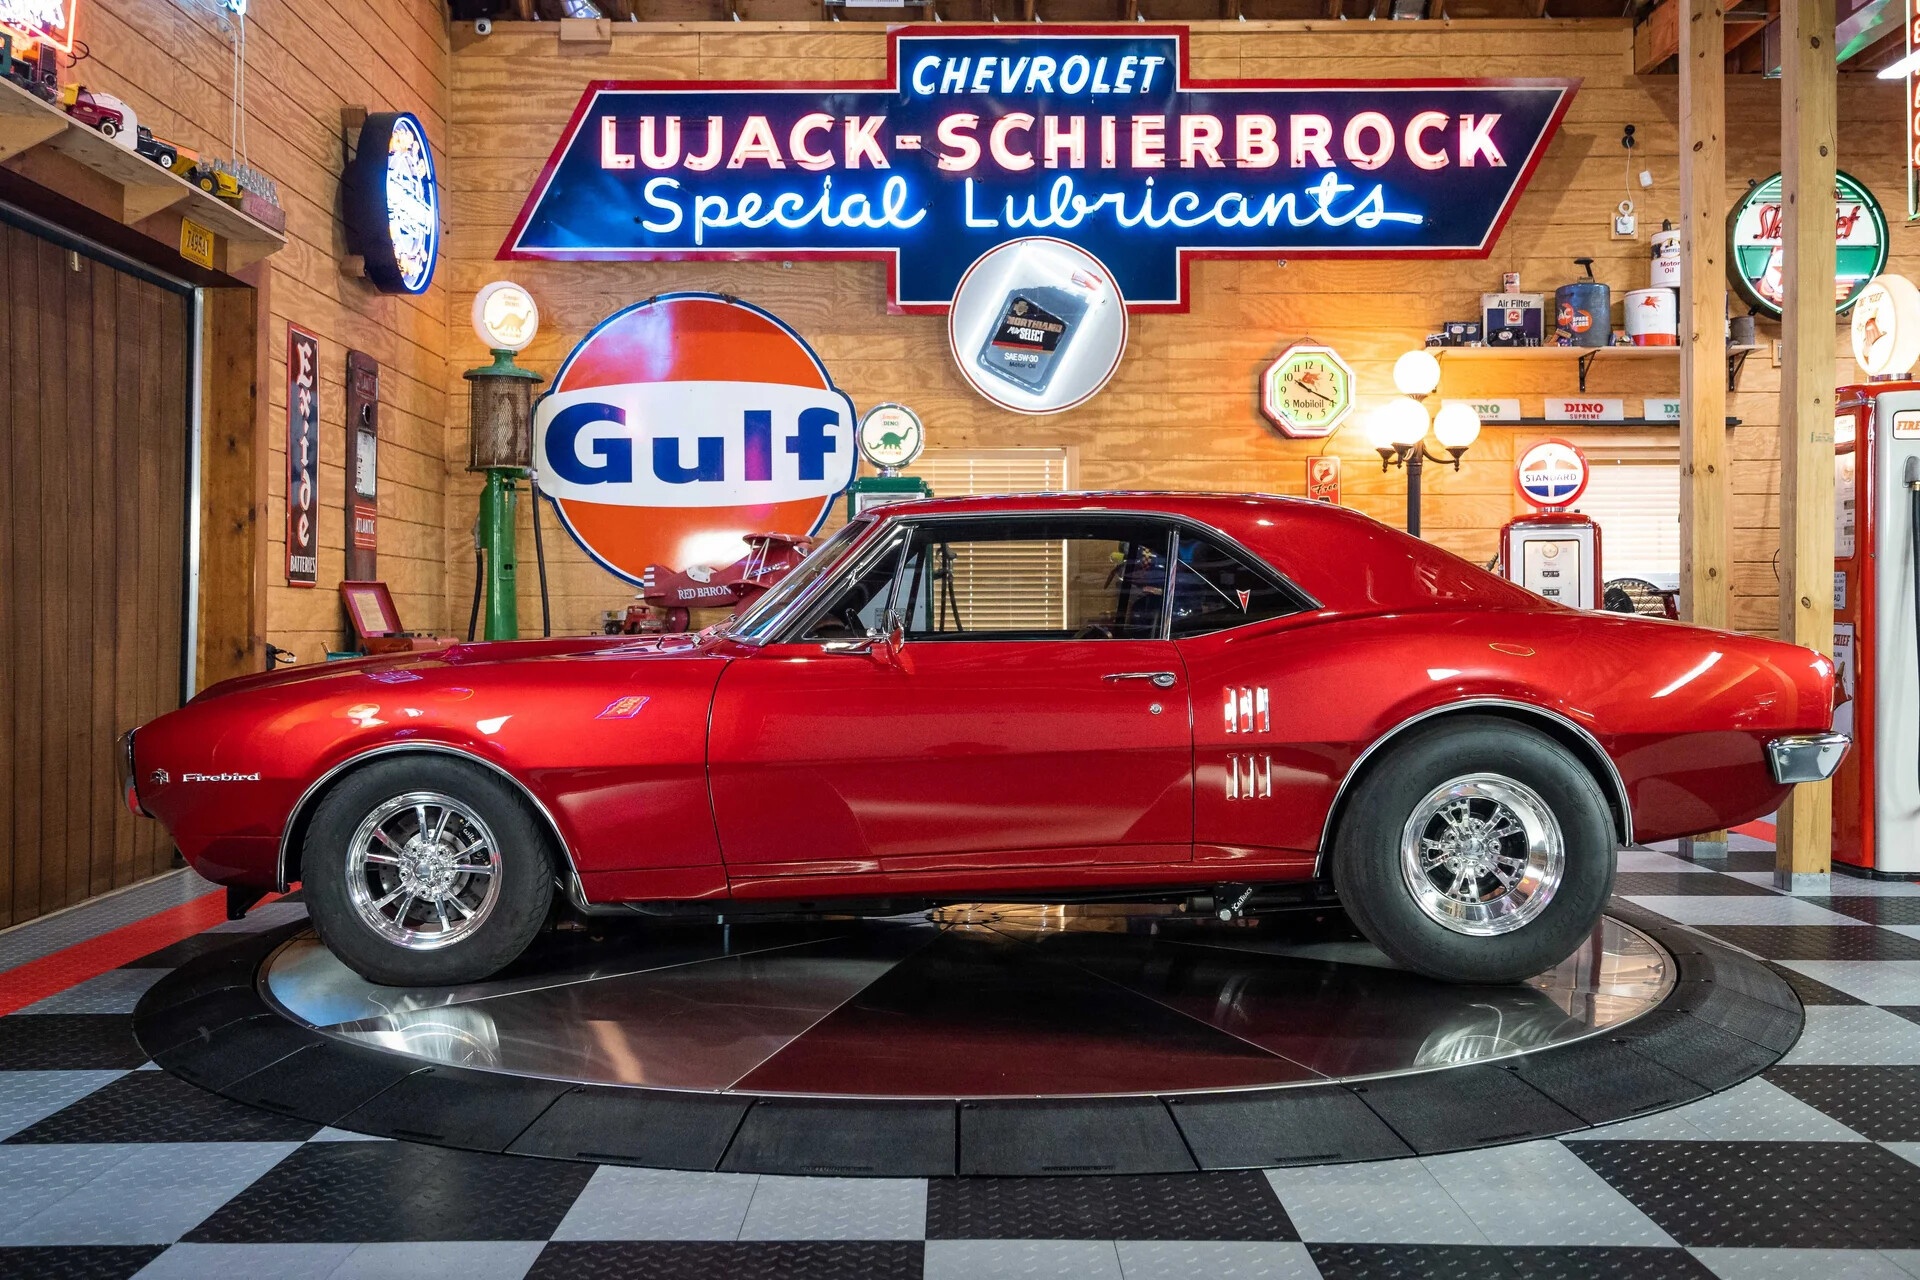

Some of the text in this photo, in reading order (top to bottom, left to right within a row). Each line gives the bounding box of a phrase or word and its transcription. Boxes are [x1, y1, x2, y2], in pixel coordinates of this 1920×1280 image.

[912, 55, 1166, 96] CHEVROLET
[600, 111, 1508, 172] LUJACK-SCHIERBROCK
[641, 171, 1424, 245] Special Lubricants
[1497, 299, 1532, 308] Air Filter
[1558, 307, 1572, 320] AC
[1004, 352, 1018, 361] SAE
[1294, 364, 1300, 373] 11
[1305, 361, 1314, 370] 12
[1284, 372, 1335, 382] 10 2
[1280, 386, 1338, 395] 9 3
[1284, 399, 1290, 408] 8
[1292, 399, 1324, 409] Mobiloil
[1564, 403, 1604, 413] DINO
[1293, 408, 1326, 417] 7 5
[1306, 412, 1313, 421] 6
[296, 341, 314, 548] Exide
[544, 402, 840, 485] Gulf
[1311, 483, 1338, 495] Free
[356, 516, 375, 535] ATLANTIC
[290, 552, 317, 574] BATTERIES
[677, 585, 732, 600] RED BARON
[182, 772, 261, 782] Firebird
